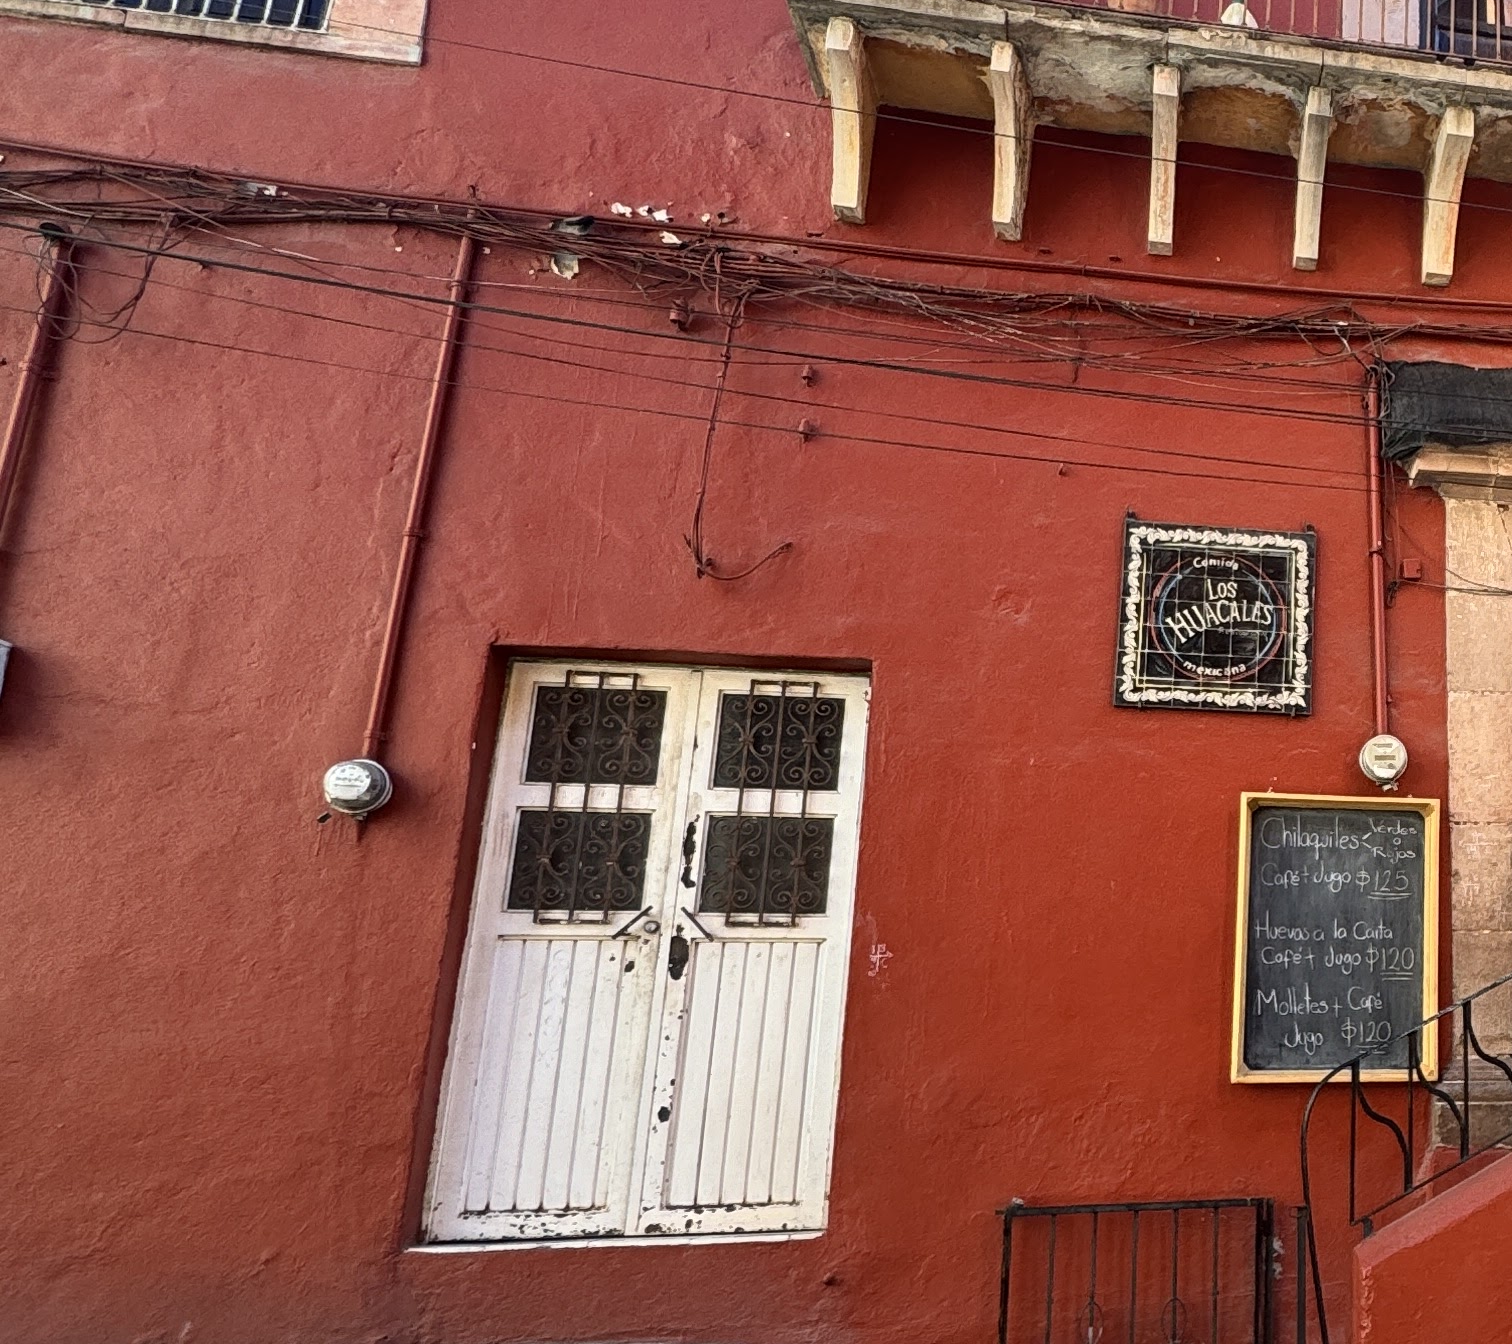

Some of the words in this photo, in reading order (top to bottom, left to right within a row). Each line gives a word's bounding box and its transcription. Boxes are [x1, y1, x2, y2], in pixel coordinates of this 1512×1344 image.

[1193, 557, 1239, 570] Comida
[1207, 579, 1238, 600] LOS
[1165, 599, 1273, 644] HUACALES
[1183, 661, 1246, 676] mexicana
[1261, 815, 1359, 860] Chilaquiles
[1393, 837, 1401, 846] o
[1313, 861, 1352, 893] Jugo
[1255, 910, 1309, 940] Huevos
[1313, 929, 1325, 941] a
[1334, 918, 1347, 939] la
[1353, 917, 1393, 940] Carta
[1325, 946, 1362, 975] Jugo
[1366, 943, 1415, 973] $120
[1257, 982, 1329, 1016] Molletes
[1330, 997, 1343, 1018] +
[1347, 986, 1383, 1013] Café
[1284, 1021, 1324, 1055] Jugo
[1341, 1017, 1392, 1047] $120
